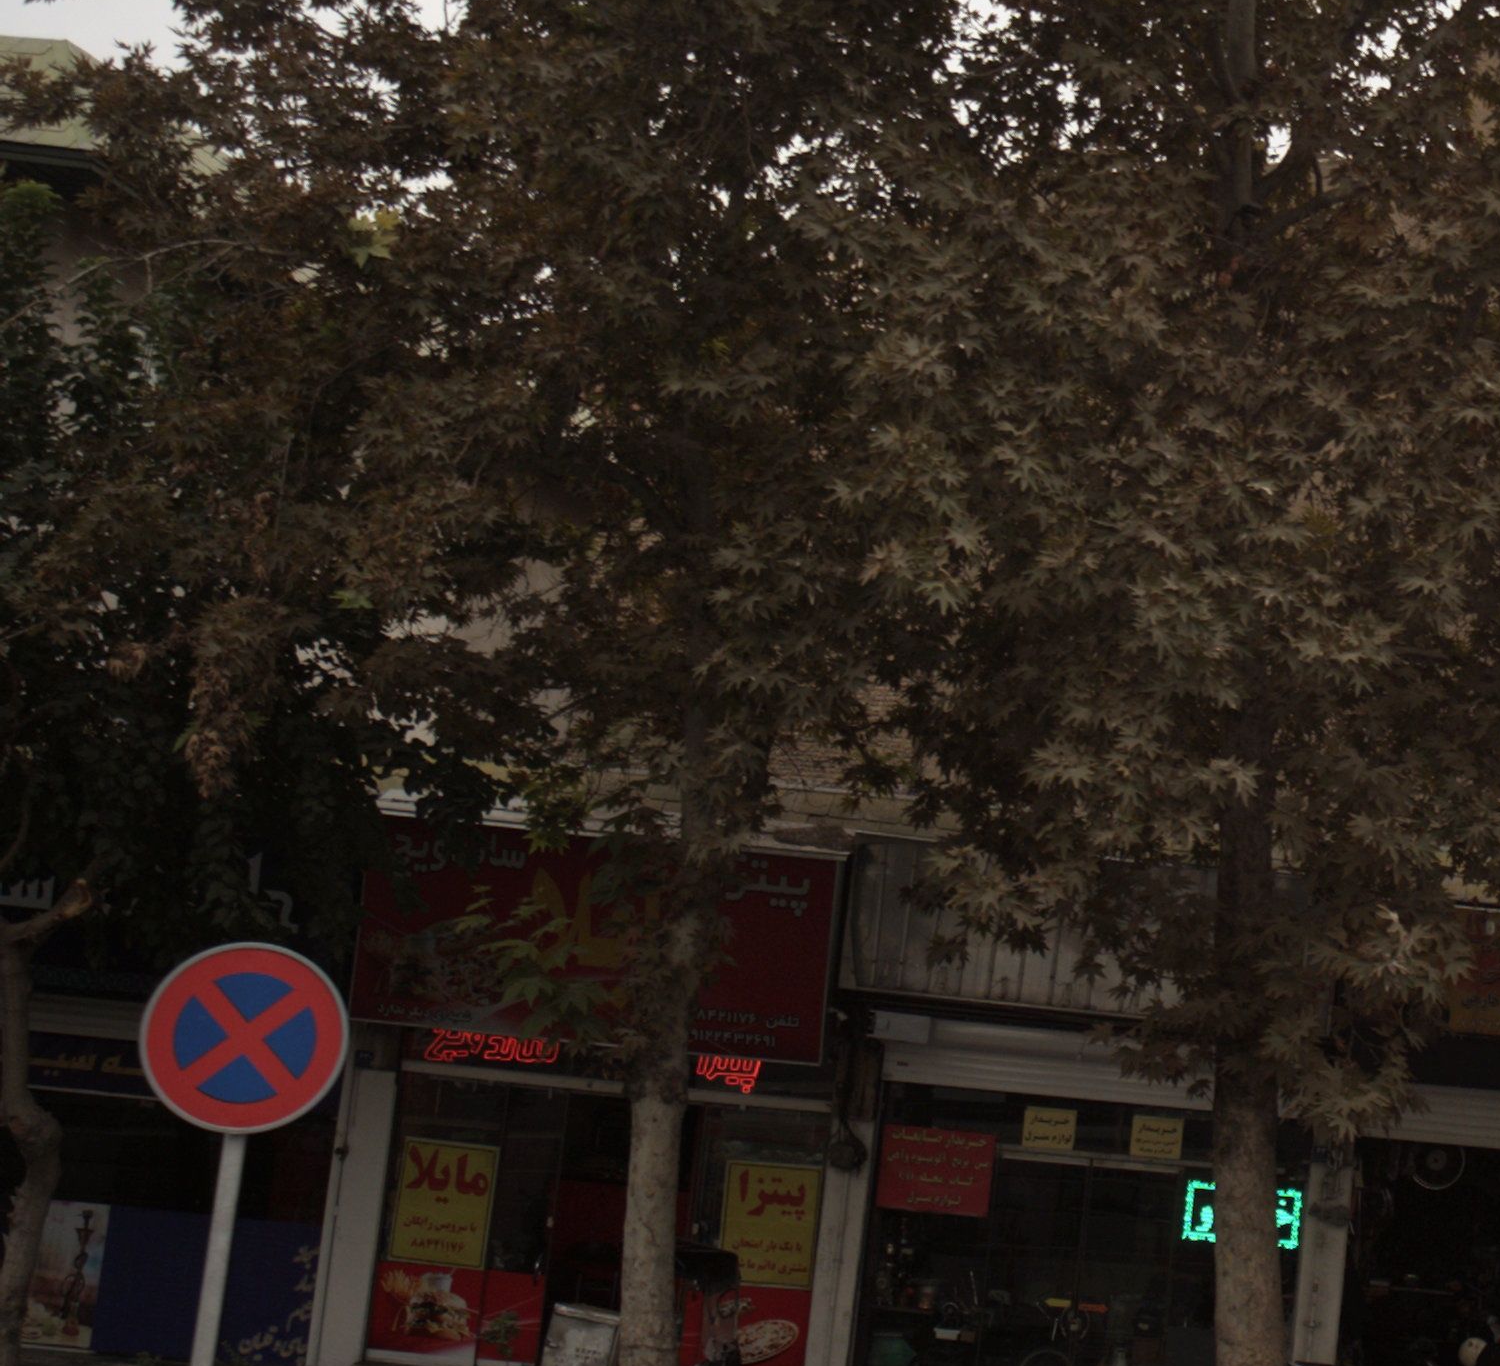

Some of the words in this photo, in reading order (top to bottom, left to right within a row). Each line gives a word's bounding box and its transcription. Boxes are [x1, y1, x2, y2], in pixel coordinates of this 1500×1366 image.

[724, 854, 811, 918] پیتز
[697, 1008, 757, 1025] ۸۴۲۱۱۷۶
[765, 1013, 800, 1029] تلفن
[404, 1144, 489, 1205] مایلا
[738, 1168, 807, 1221] پیتزا
